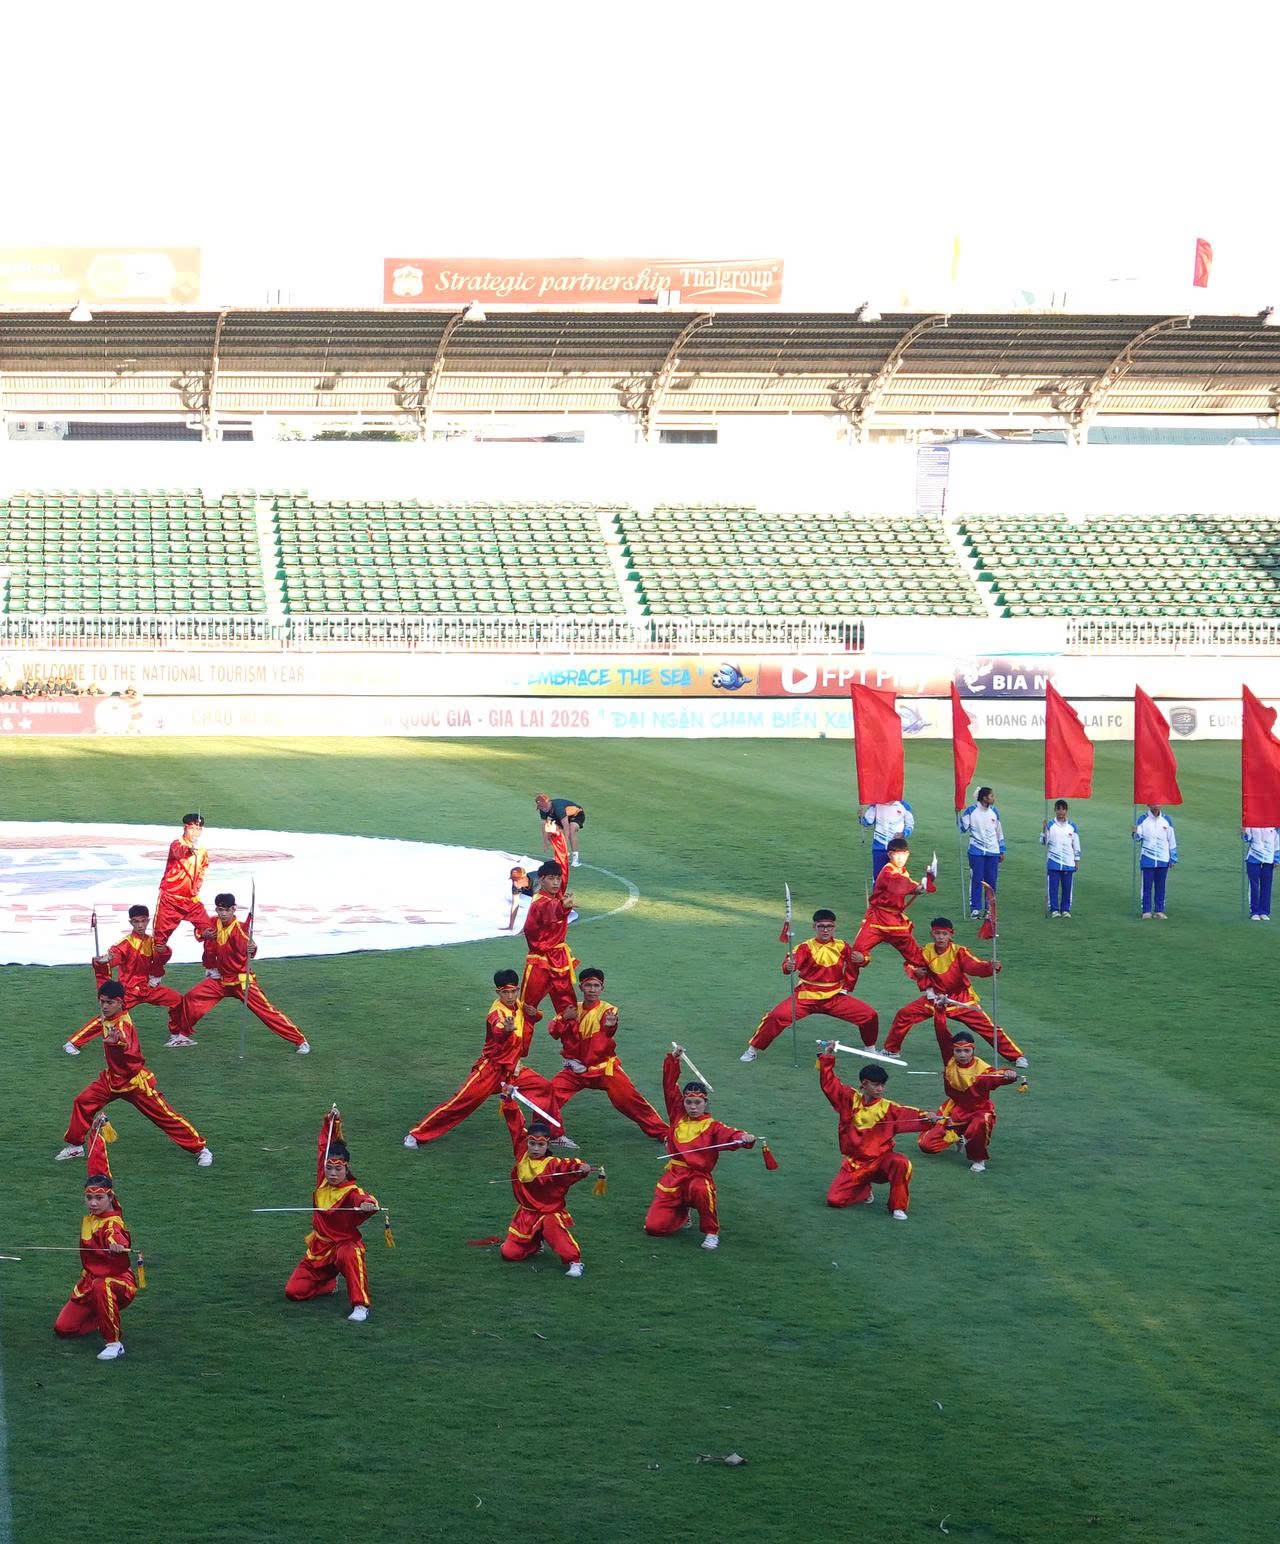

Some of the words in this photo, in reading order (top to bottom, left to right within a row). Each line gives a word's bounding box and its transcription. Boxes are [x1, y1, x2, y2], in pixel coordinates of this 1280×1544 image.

[435, 270, 536, 297] Strategic
[537, 266, 671, 298] partnership
[22, 663, 87, 682] WELCOME
[91, 664, 108, 682] TO
[112, 664, 137, 682] THE
[142, 664, 205, 683] NATIONAL
[210, 664, 267, 683] TOURISM
[272, 664, 305, 683] YEAR
[617, 667, 653, 686] THE
[660, 666, 692, 687] SEA
[823, 665, 867, 687] FPT
[992, 675, 1028, 690] BIA
[446, 709, 472, 728] GIA
[488, 709, 514, 728] GIA
[519, 709, 544, 728] LAI
[550, 709, 591, 729] 2026
[823, 711, 853, 729] XA
[986, 714, 1028, 728] HOANG
[1106, 713, 1123, 728] FC
